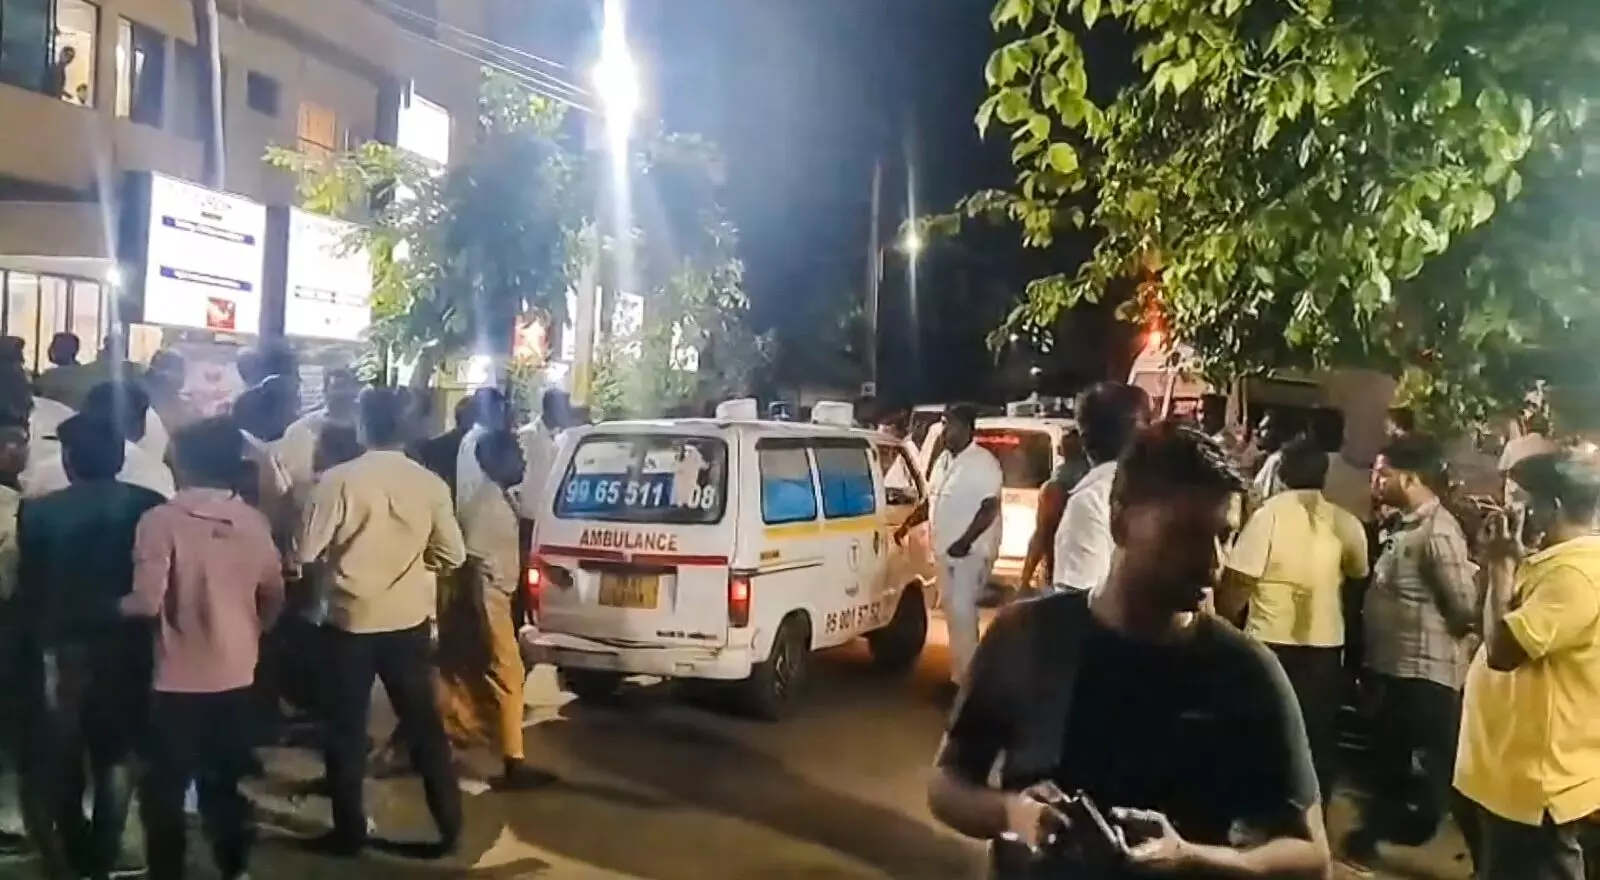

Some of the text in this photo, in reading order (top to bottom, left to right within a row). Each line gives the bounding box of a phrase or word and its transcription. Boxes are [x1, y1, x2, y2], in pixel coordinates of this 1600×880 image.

[566, 479, 589, 502] 99
[595, 479, 621, 505] 65
[624, 481, 663, 506] 511
[580, 529, 678, 551] AMBULANCE
